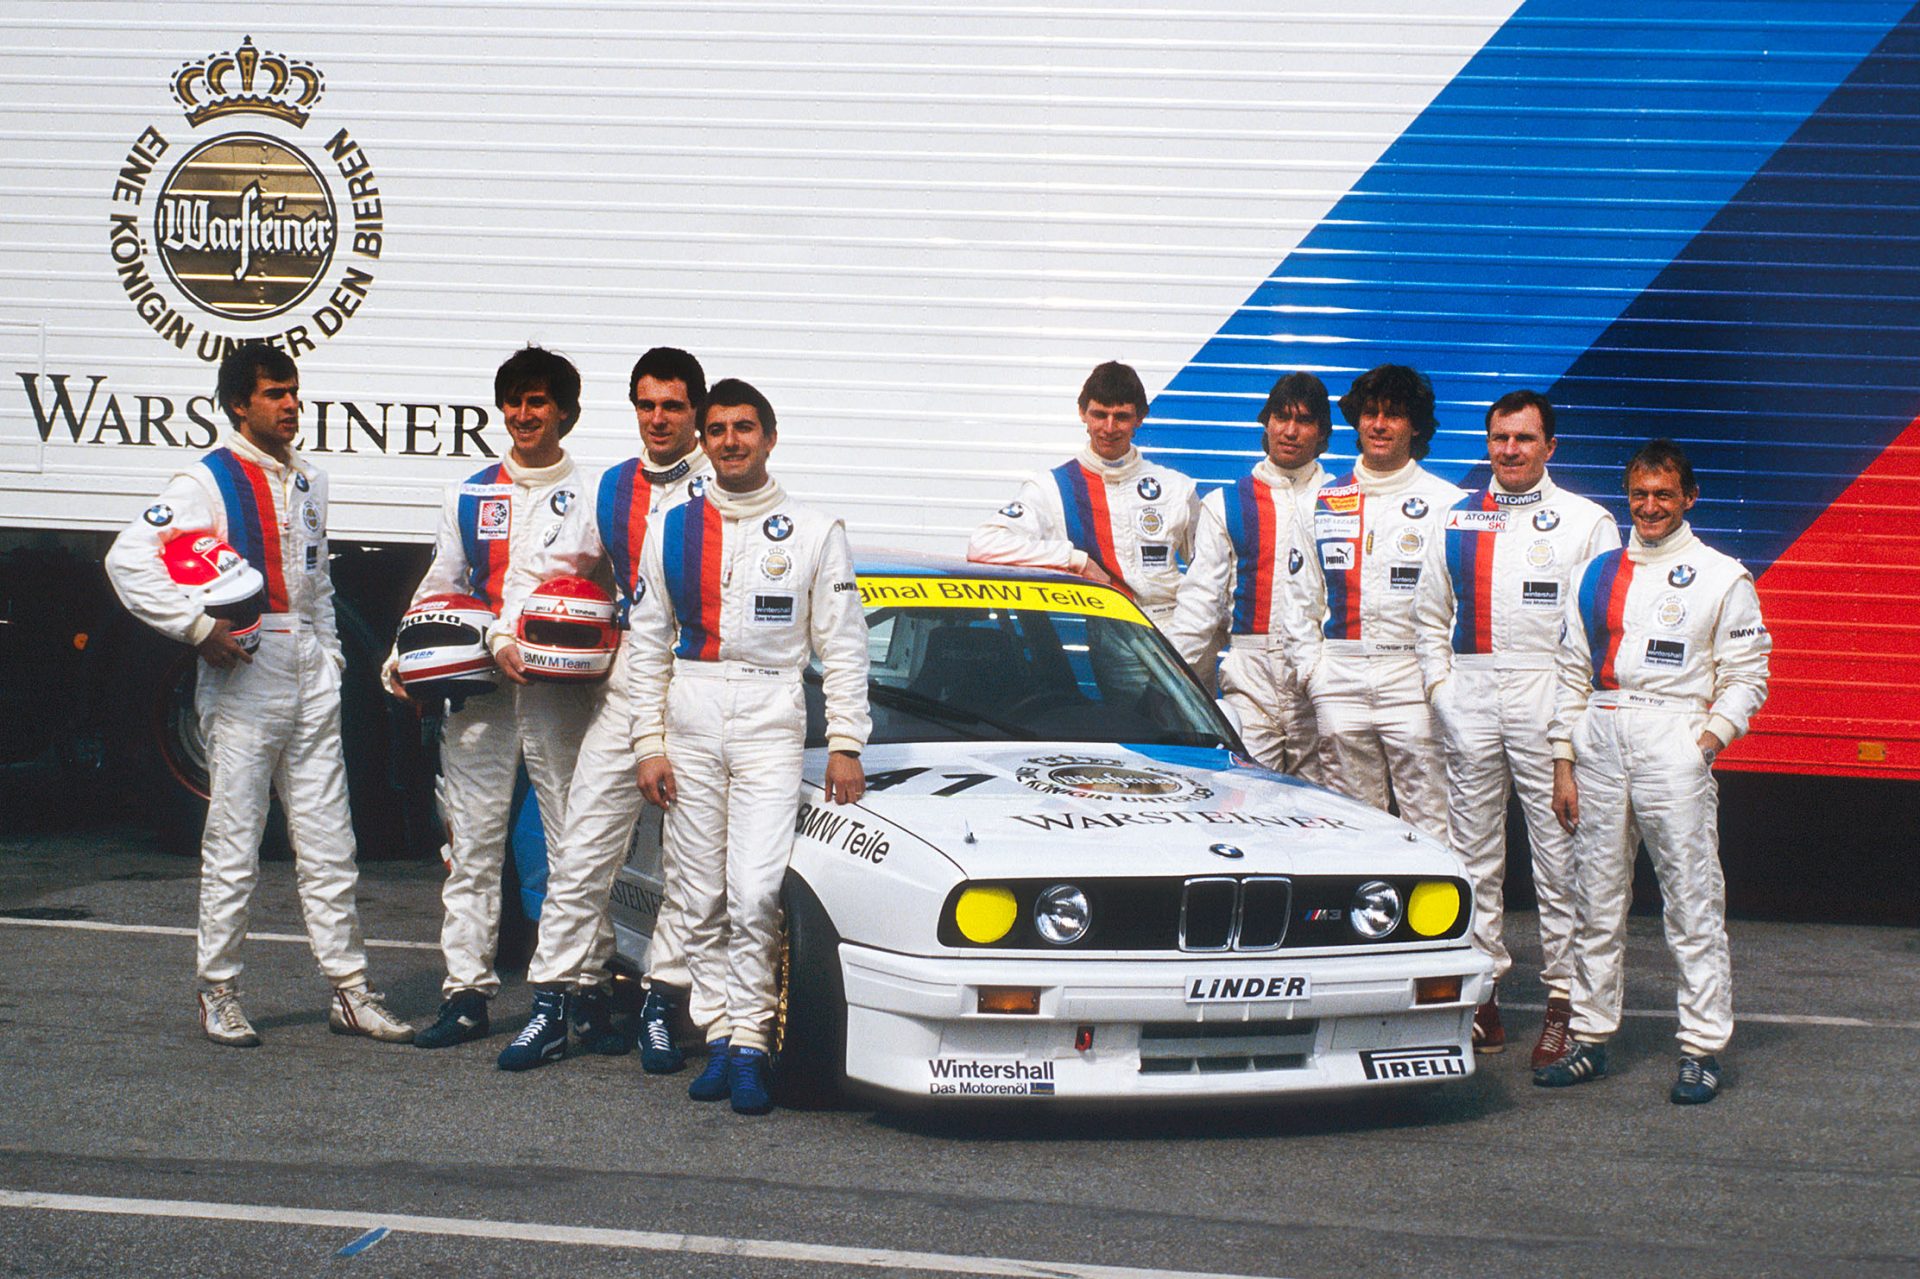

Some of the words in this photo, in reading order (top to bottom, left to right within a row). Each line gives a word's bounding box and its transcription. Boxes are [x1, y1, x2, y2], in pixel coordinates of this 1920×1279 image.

[112, 125, 170, 205] EINE
[324, 127, 384, 259] BIEREN
[163, 180, 334, 280] Warsteiner
[110, 213, 194, 349] KÖNIGIN
[312, 267, 374, 339] DEN
[15, 372, 499, 459] WARSINER
[1495, 492, 1540, 504] ATOMIC
[1464, 513, 1506, 521] ATOMIC
[1488, 521, 1506, 530] SKI
[1325, 555, 1345, 564] PUMA
[937, 582, 1022, 601] BMW
[1029, 586, 1106, 611] Teile
[1730, 628, 1756, 639] BMW
[524, 651, 548, 666] BMW
[548, 657, 560, 667] M
[561, 657, 591, 669] Team
[1009, 811, 1364, 832] WARSTEINER
[795, 803, 849, 844] BMW
[841, 821, 890, 864] Teile
[1190, 976, 1306, 999] LINDER
[928, 1059, 1055, 1080] Wintershall
[1358, 1044, 1467, 1080] PIRELLI
[929, 1083, 956, 1095] Das
[959, 1081, 1028, 1095] Motorenöl
